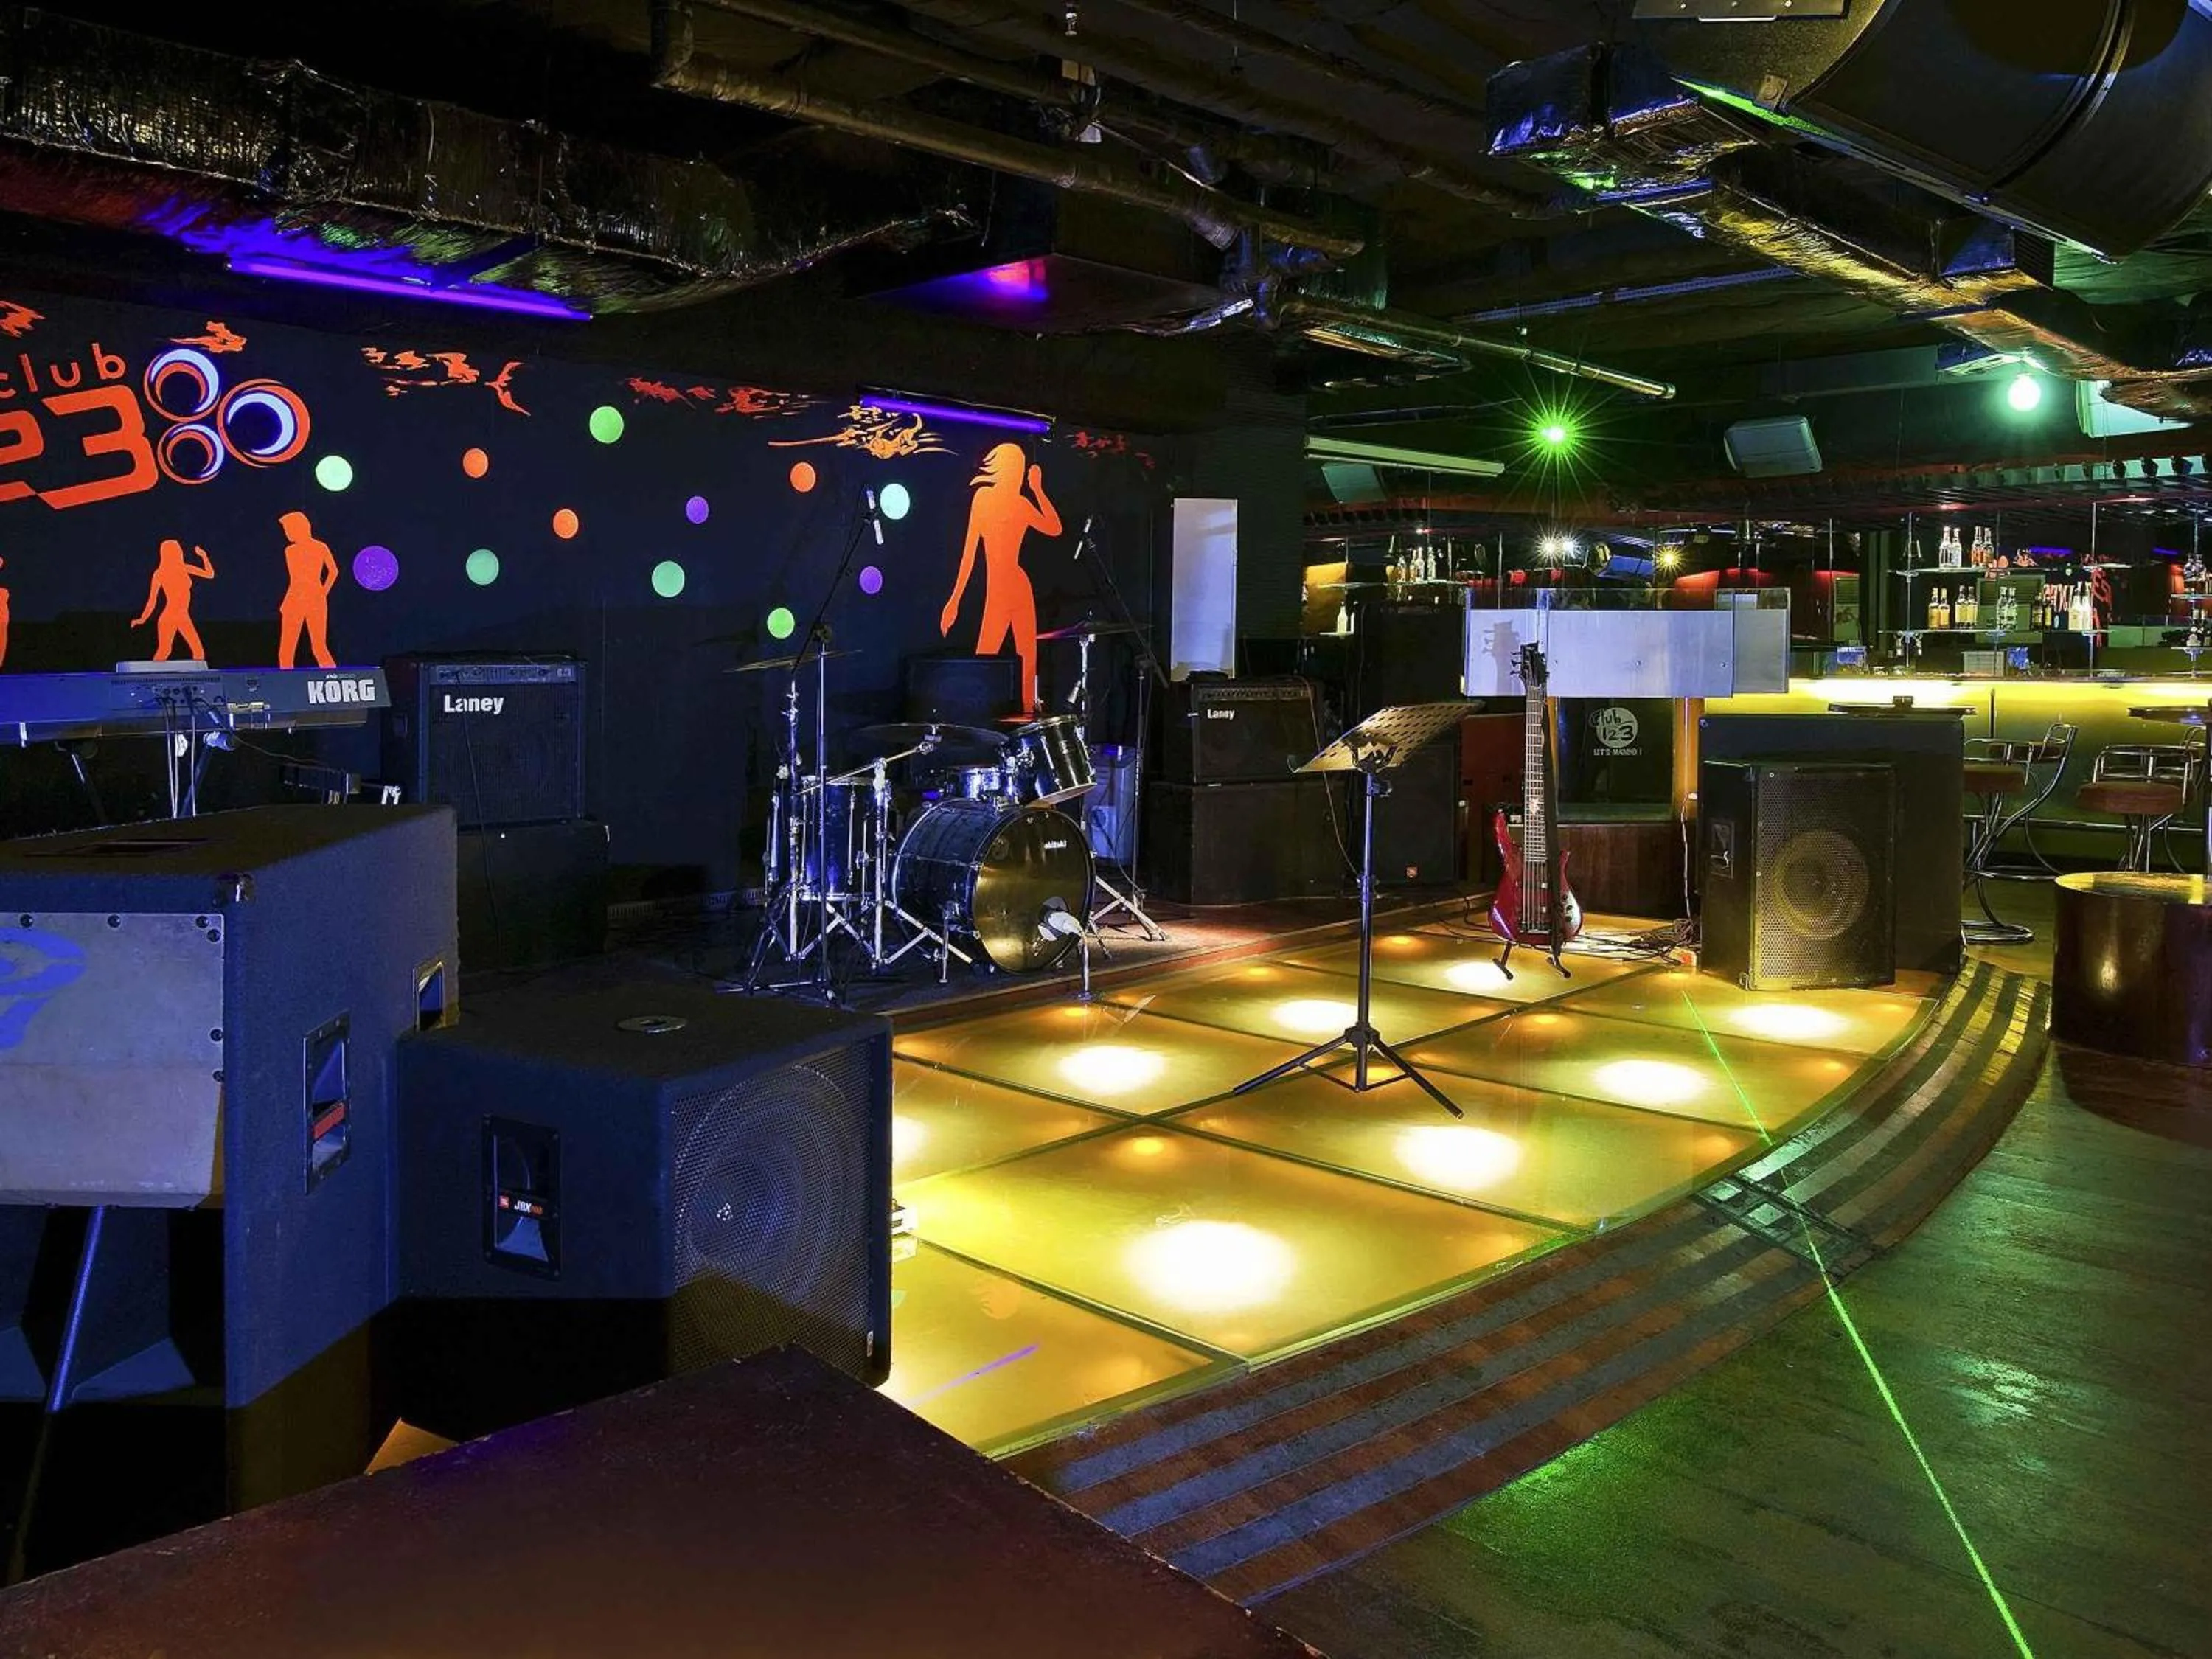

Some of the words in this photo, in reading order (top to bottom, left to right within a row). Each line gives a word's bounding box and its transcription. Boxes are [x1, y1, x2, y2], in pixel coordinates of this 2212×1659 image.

[307, 679, 375, 704] KORG
[445, 695, 504, 714] Laney
[1207, 709, 1235, 720] Laney
[1602, 726, 1635, 741] 123
